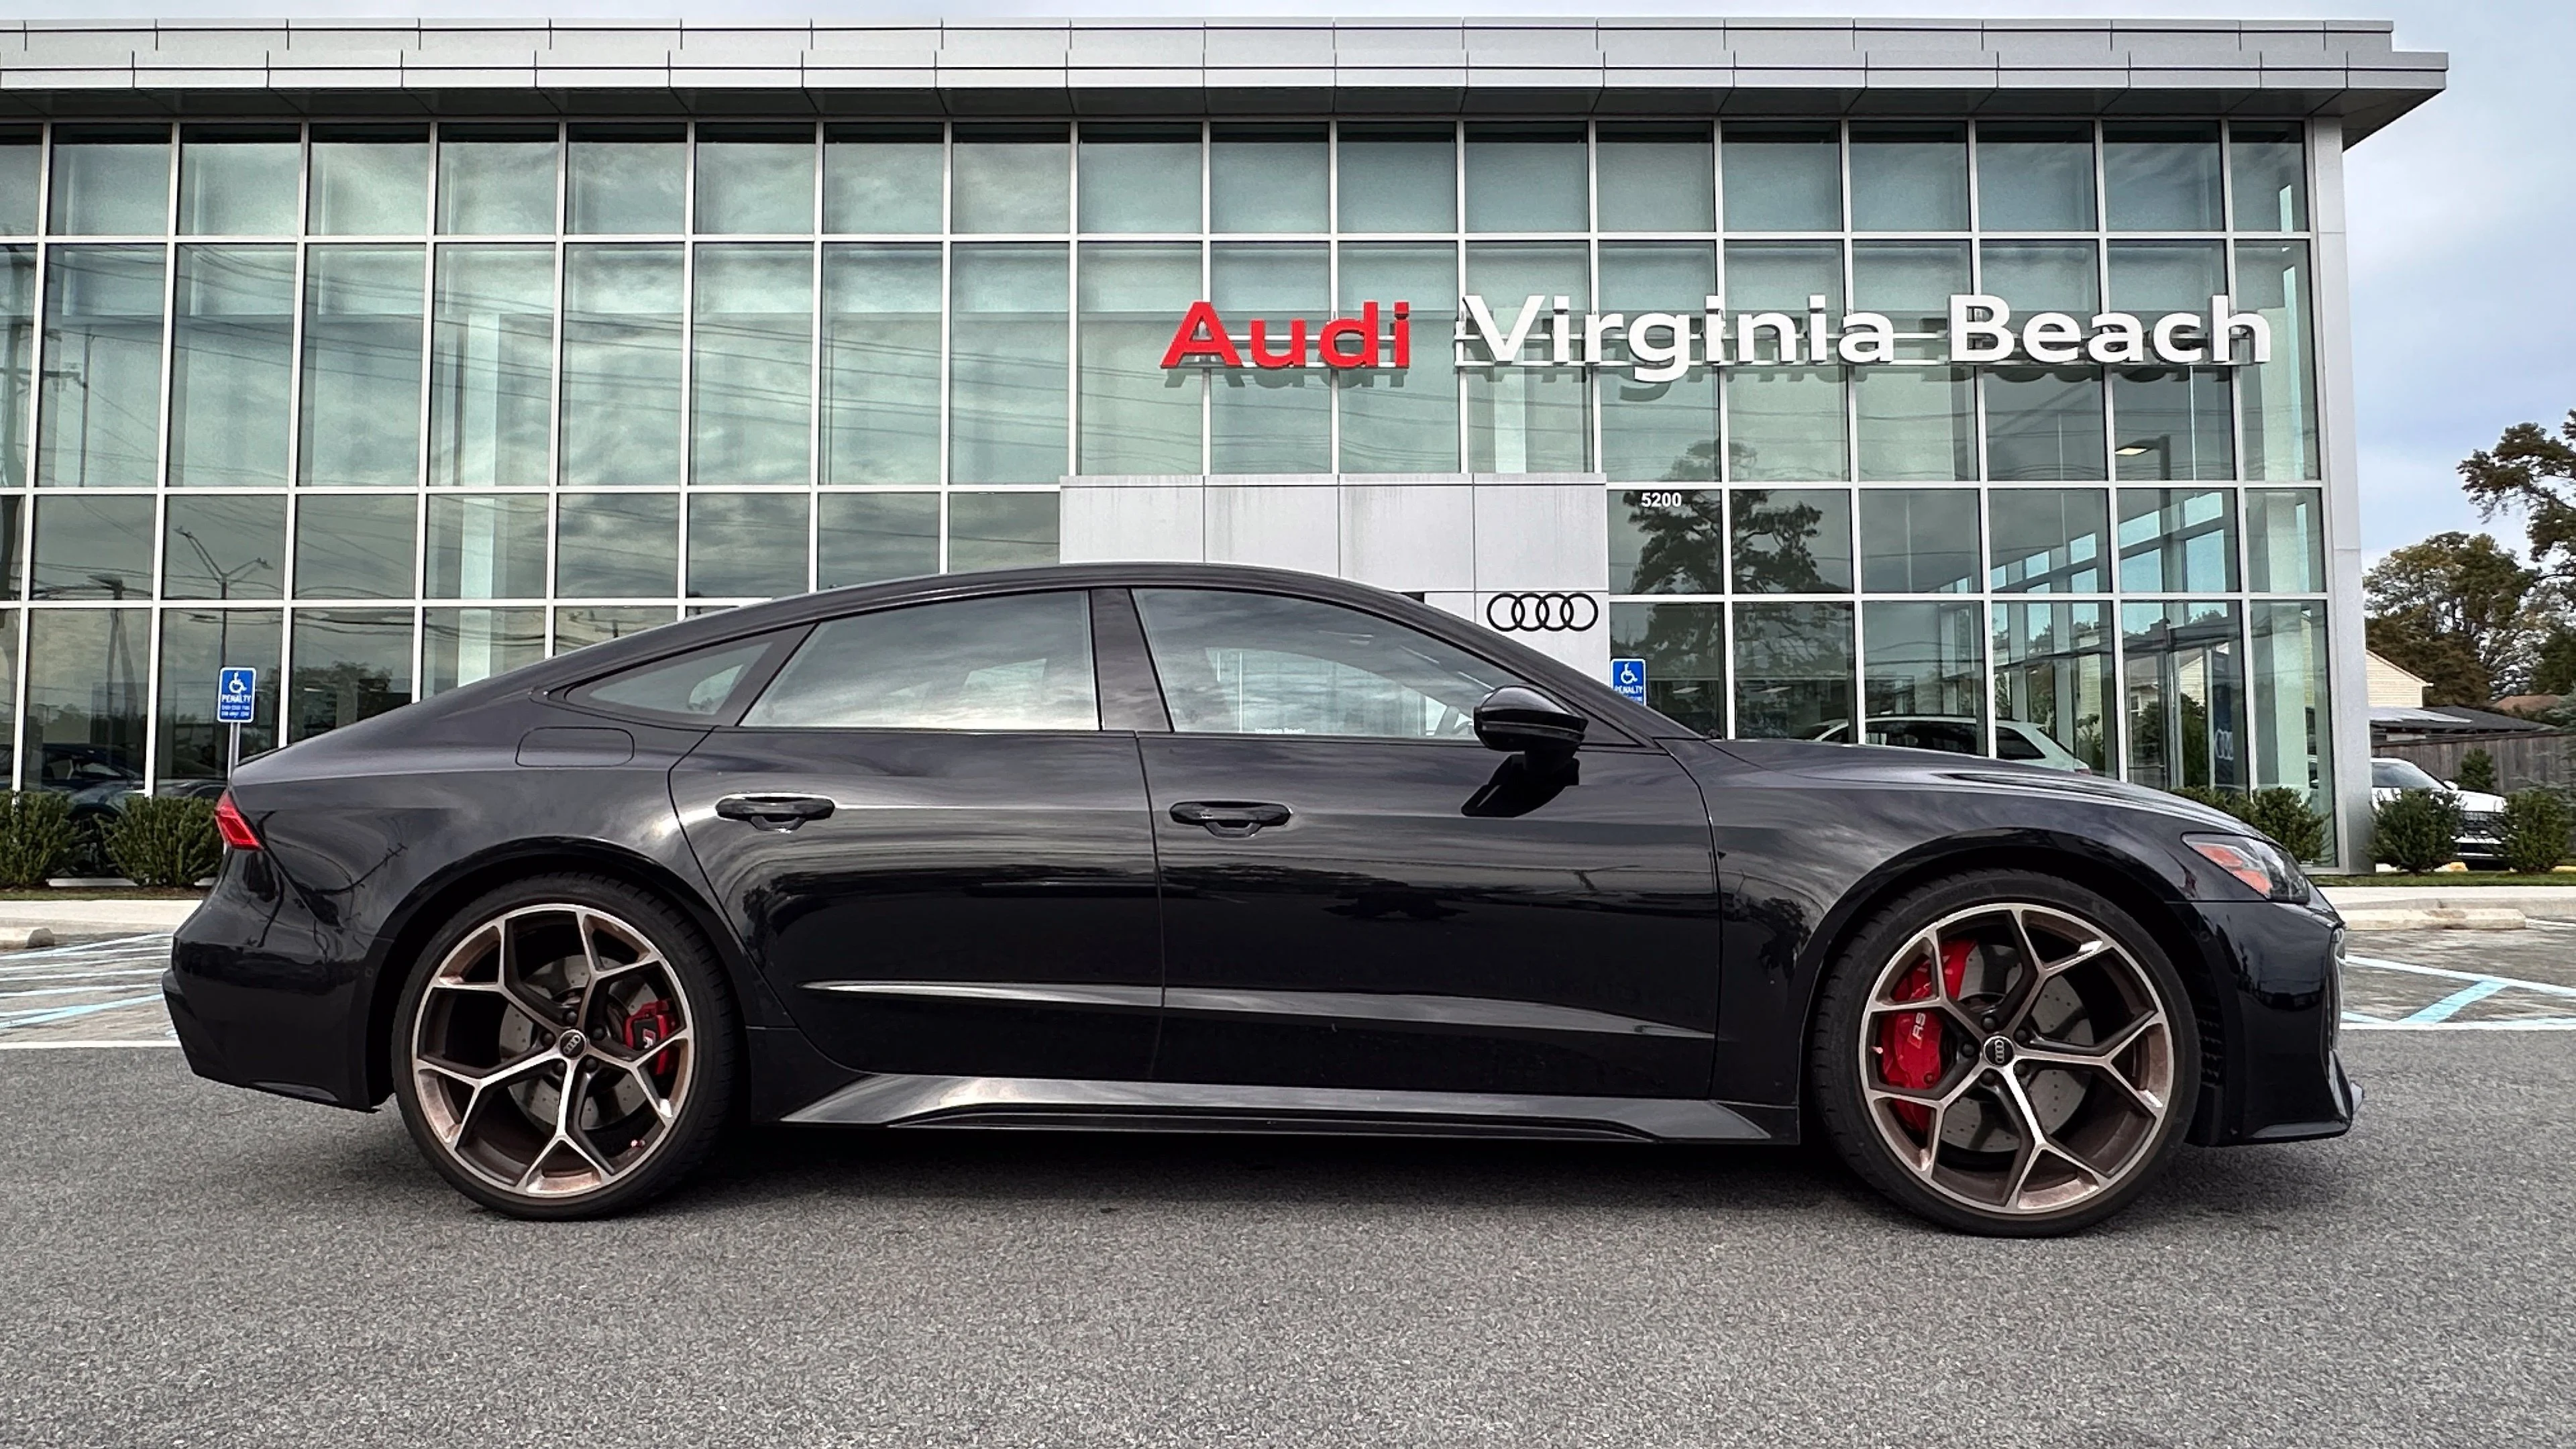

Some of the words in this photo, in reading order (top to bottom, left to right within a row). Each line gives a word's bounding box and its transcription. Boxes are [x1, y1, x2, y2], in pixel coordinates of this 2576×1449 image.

[1161, 300, 1409, 369] Audi
[1462, 295, 1894, 382] Virginia
[1949, 294, 2271, 364] Beach
[1641, 492, 1682, 508] 5200
[221, 694, 252, 703] PENALTY
[1912, 1012, 1926, 1040] RS
